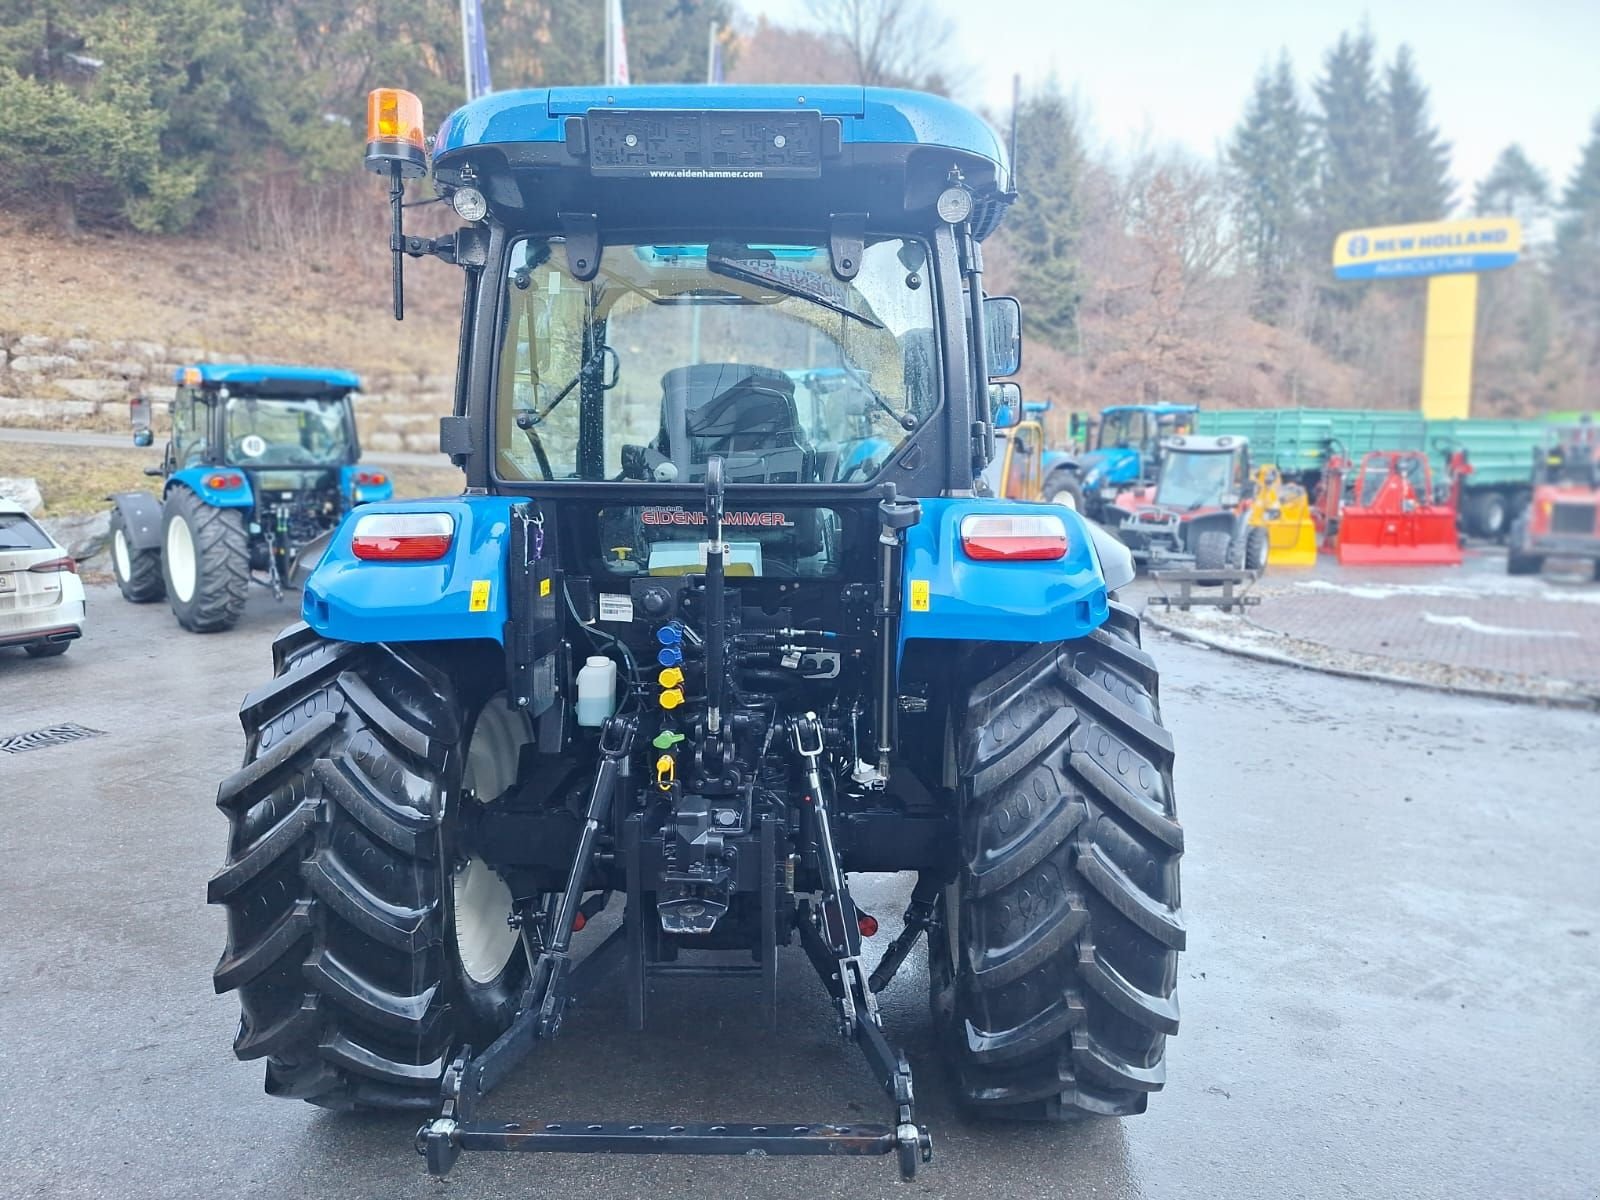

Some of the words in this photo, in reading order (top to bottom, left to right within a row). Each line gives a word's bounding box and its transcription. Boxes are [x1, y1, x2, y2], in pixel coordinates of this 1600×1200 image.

[649, 169, 763, 178] www.eidenhammer.com
[1375, 238, 1413, 251] NEW
[1419, 230, 1507, 247] HOLLAND
[1375, 256, 1474, 272] AGRICULTURE
[641, 512, 785, 525] EIDENHMMER
